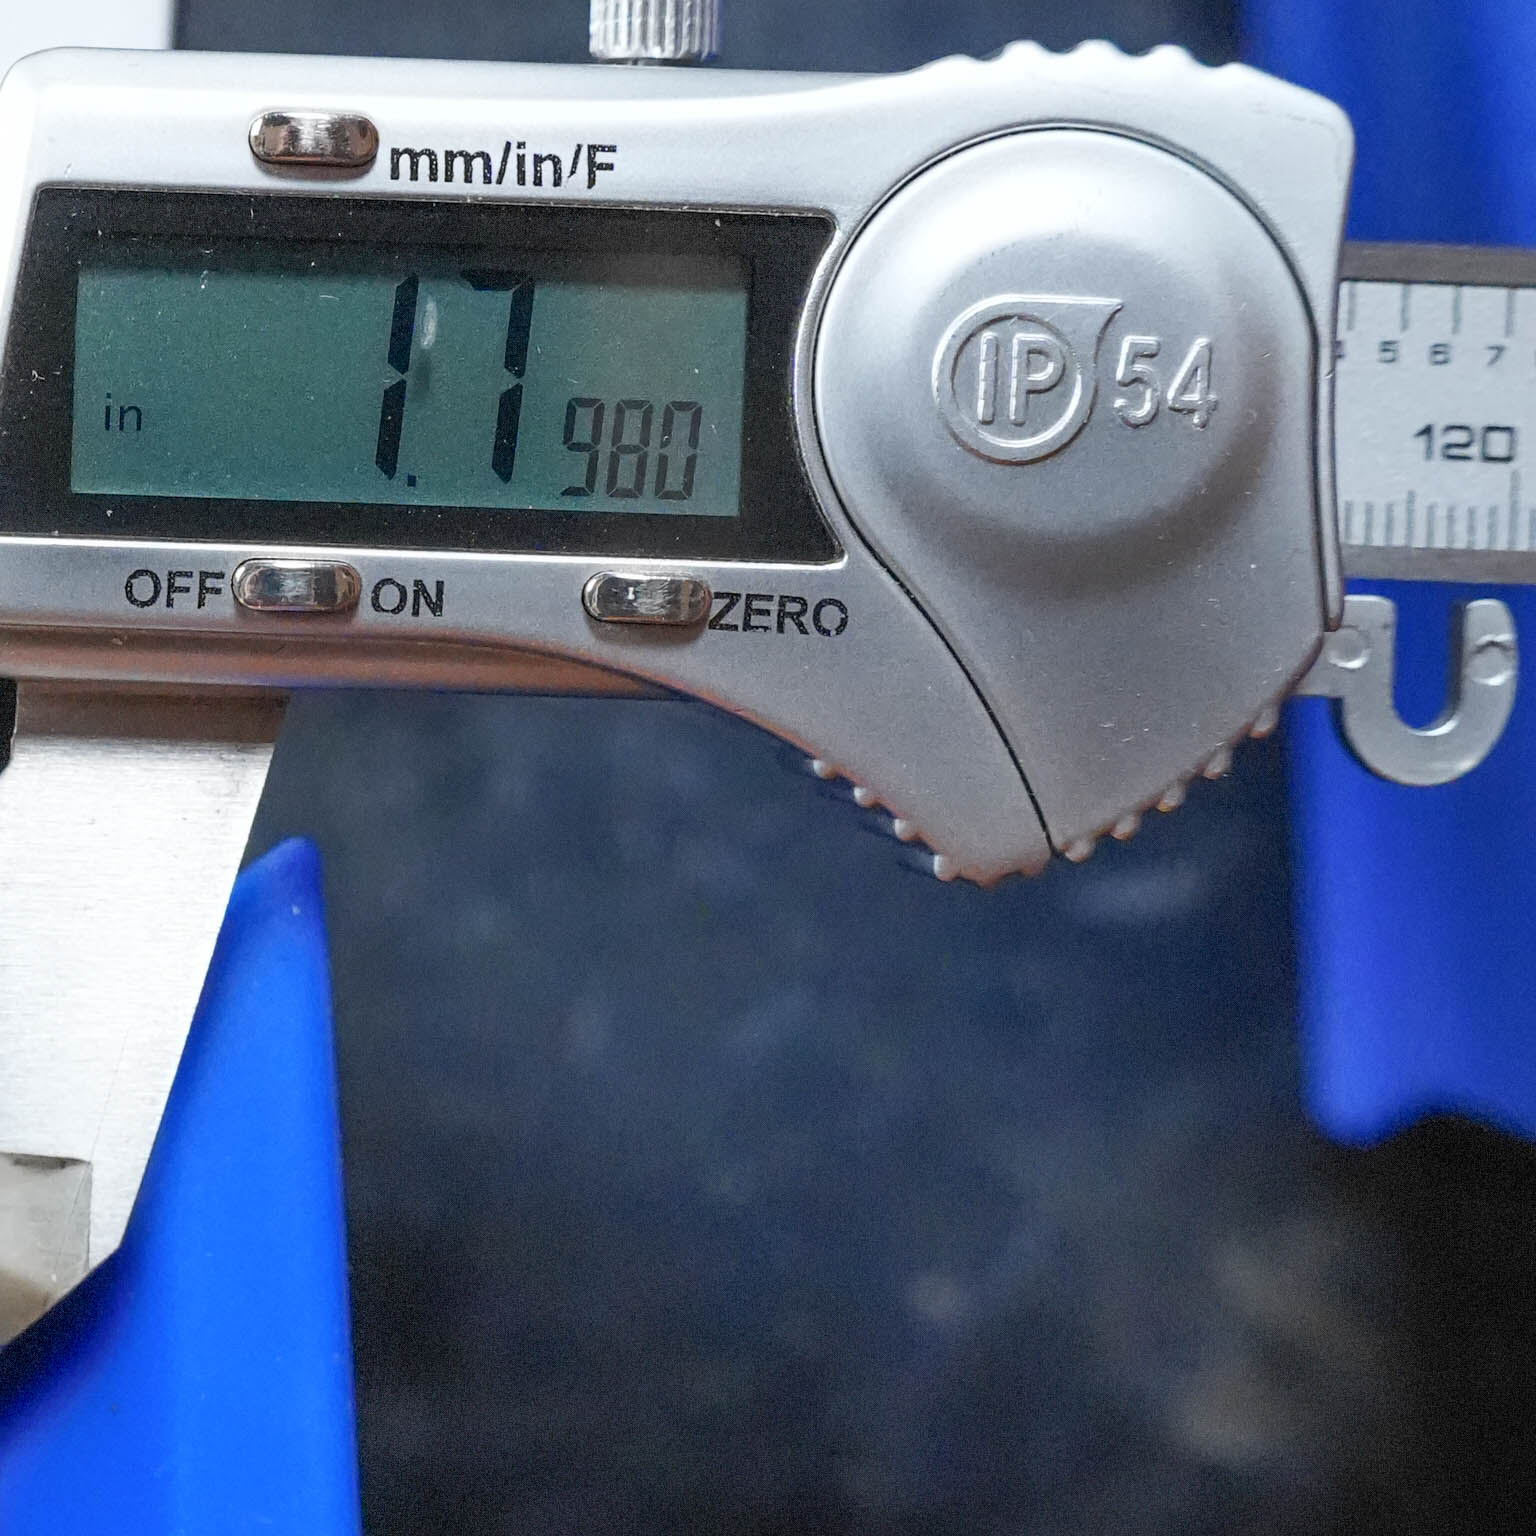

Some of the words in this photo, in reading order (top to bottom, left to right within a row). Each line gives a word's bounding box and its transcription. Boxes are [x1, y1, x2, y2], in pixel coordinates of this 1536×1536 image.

[390, 142, 619, 190] mm/in/F
[1378, 340, 1399, 364] 5
[1429, 343, 1452, 366] 6
[1486, 344, 1507, 366] 7
[977, 332, 1066, 425] IP
[1113, 335, 1218, 429] 54
[103, 394, 144, 432] in
[1414, 423, 1519, 464] 120
[125, 570, 226, 610] OFF
[371, 578, 444, 618] ON
[707, 592, 851, 638] ZERO
